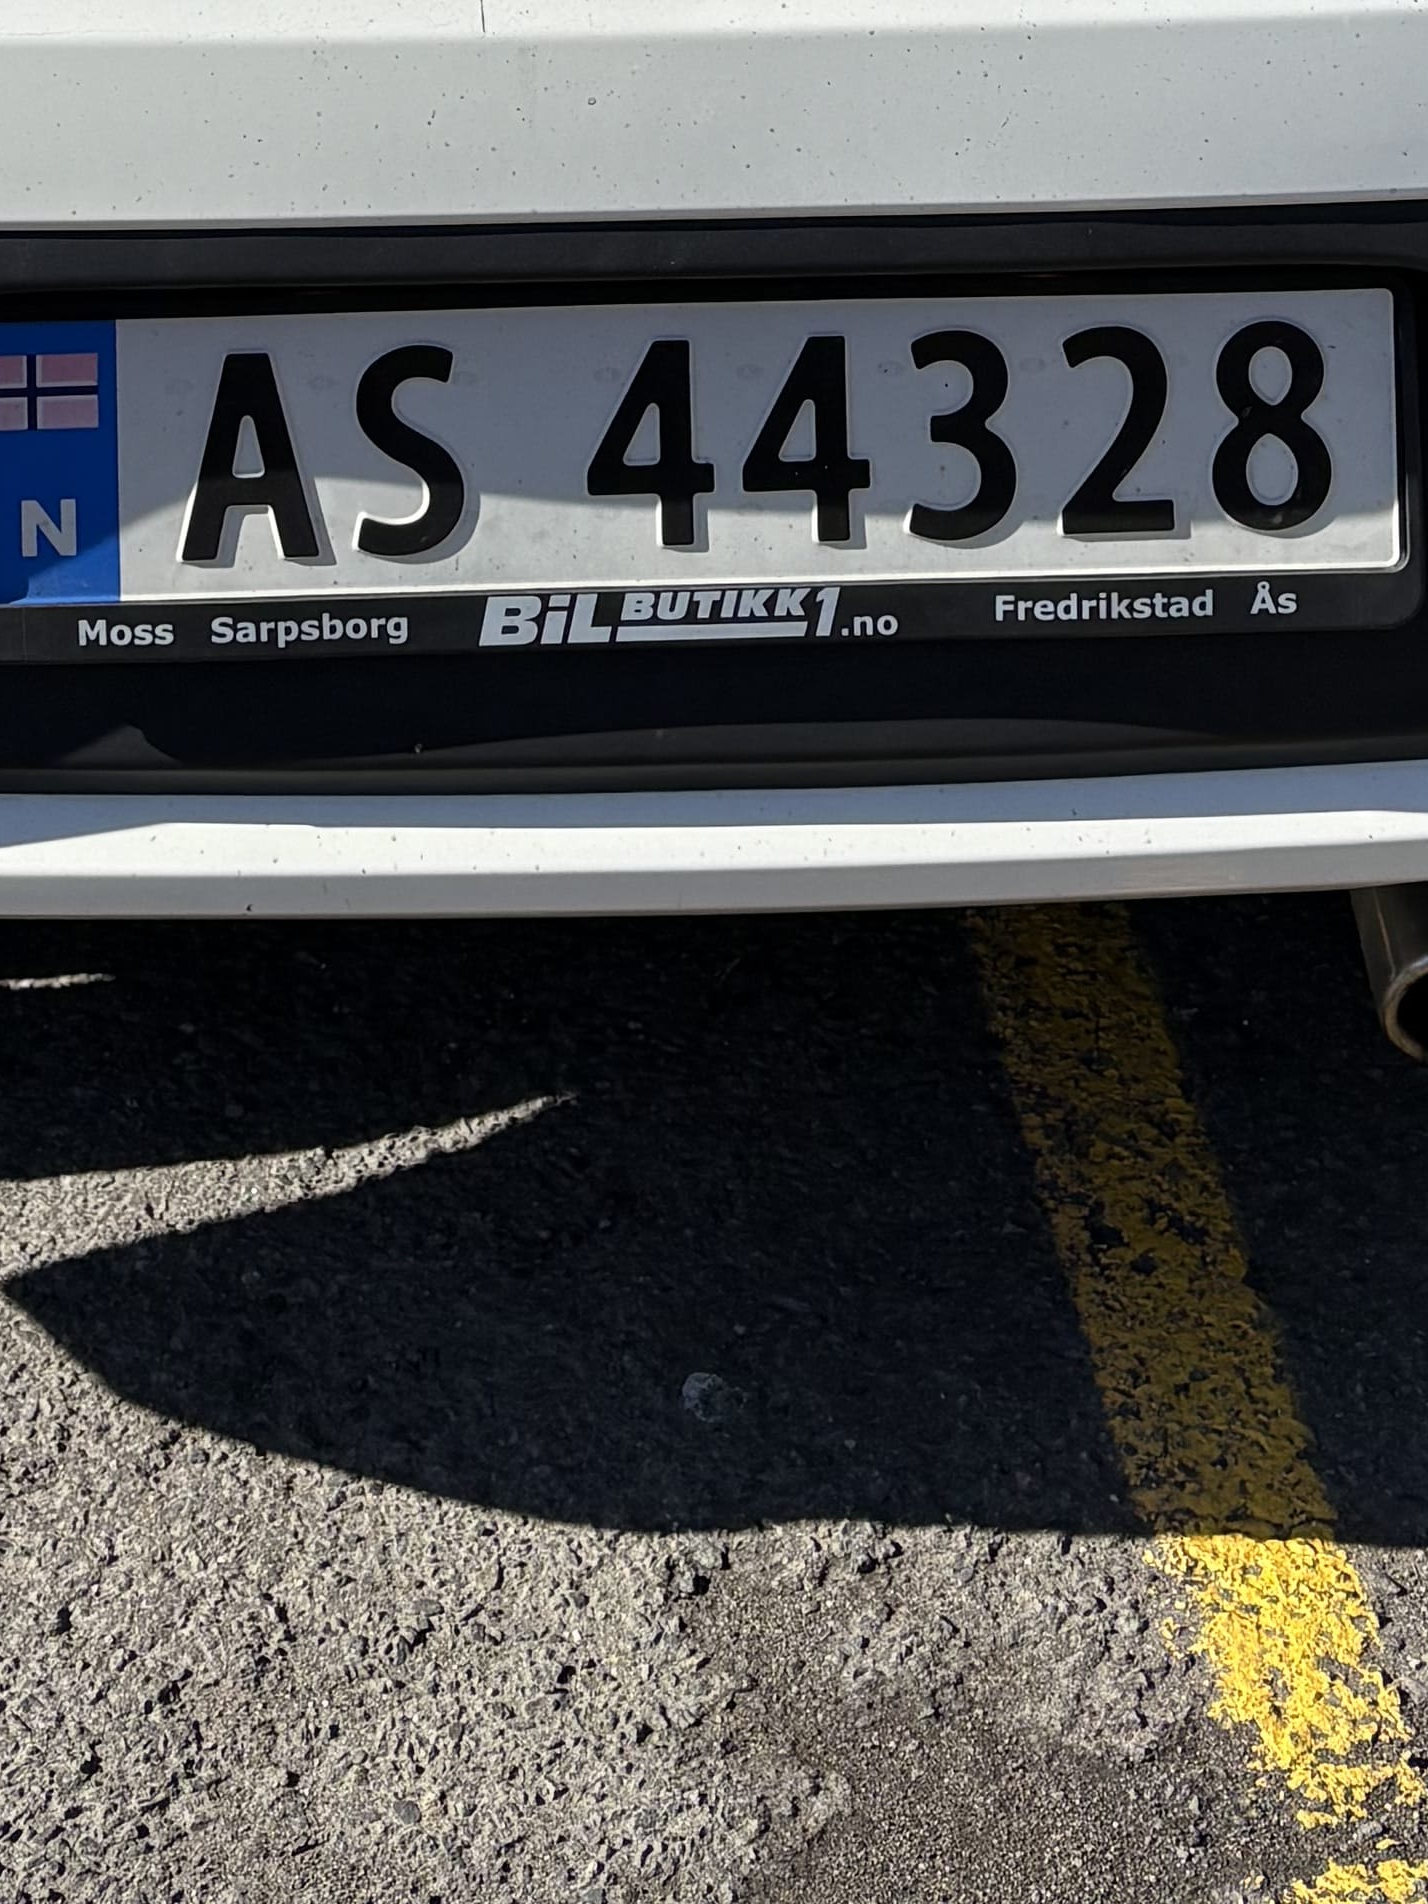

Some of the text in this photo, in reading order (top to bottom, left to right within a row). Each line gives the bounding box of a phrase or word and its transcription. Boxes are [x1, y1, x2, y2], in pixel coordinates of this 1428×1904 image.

[181, 320, 1333, 561] AS 44328
[21, 499, 77, 558] N
[994, 582, 1298, 622] Fredrikstad Ås
[77, 613, 409, 648] Moss Sarpsborg
